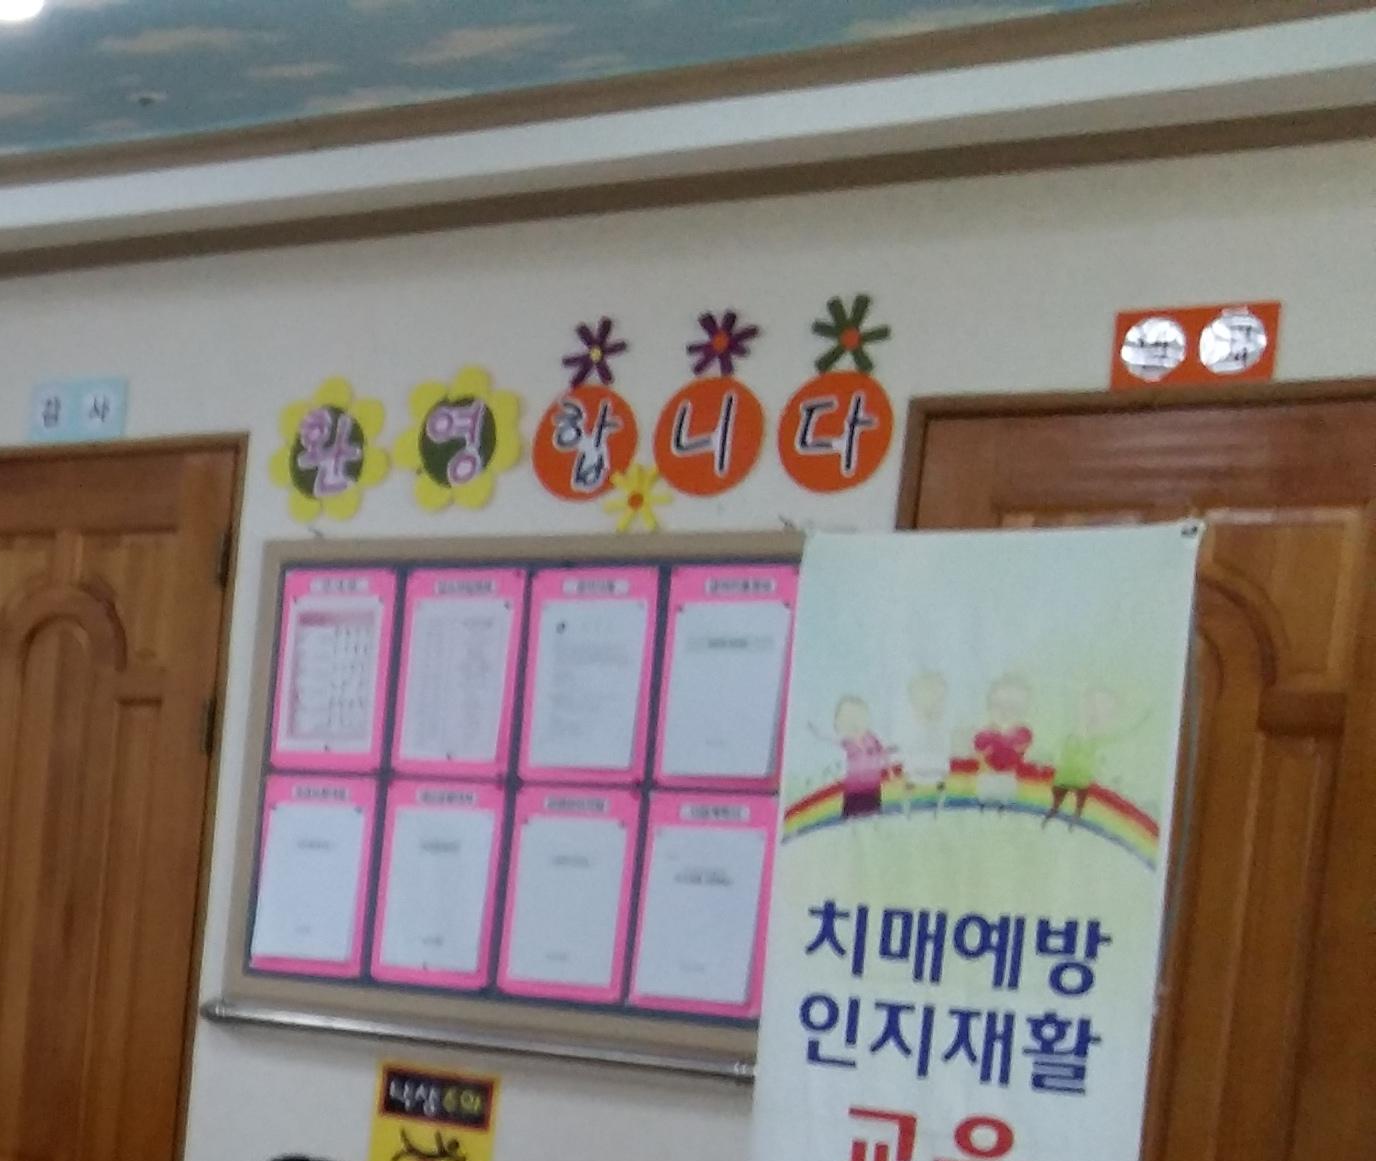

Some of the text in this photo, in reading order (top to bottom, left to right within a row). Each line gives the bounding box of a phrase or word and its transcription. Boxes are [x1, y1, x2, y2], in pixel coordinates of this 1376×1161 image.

[297, 393, 879, 497] 환영합니다
[805, 899, 1113, 997] 치매예방
[799, 993, 1102, 1097] 인지재활
